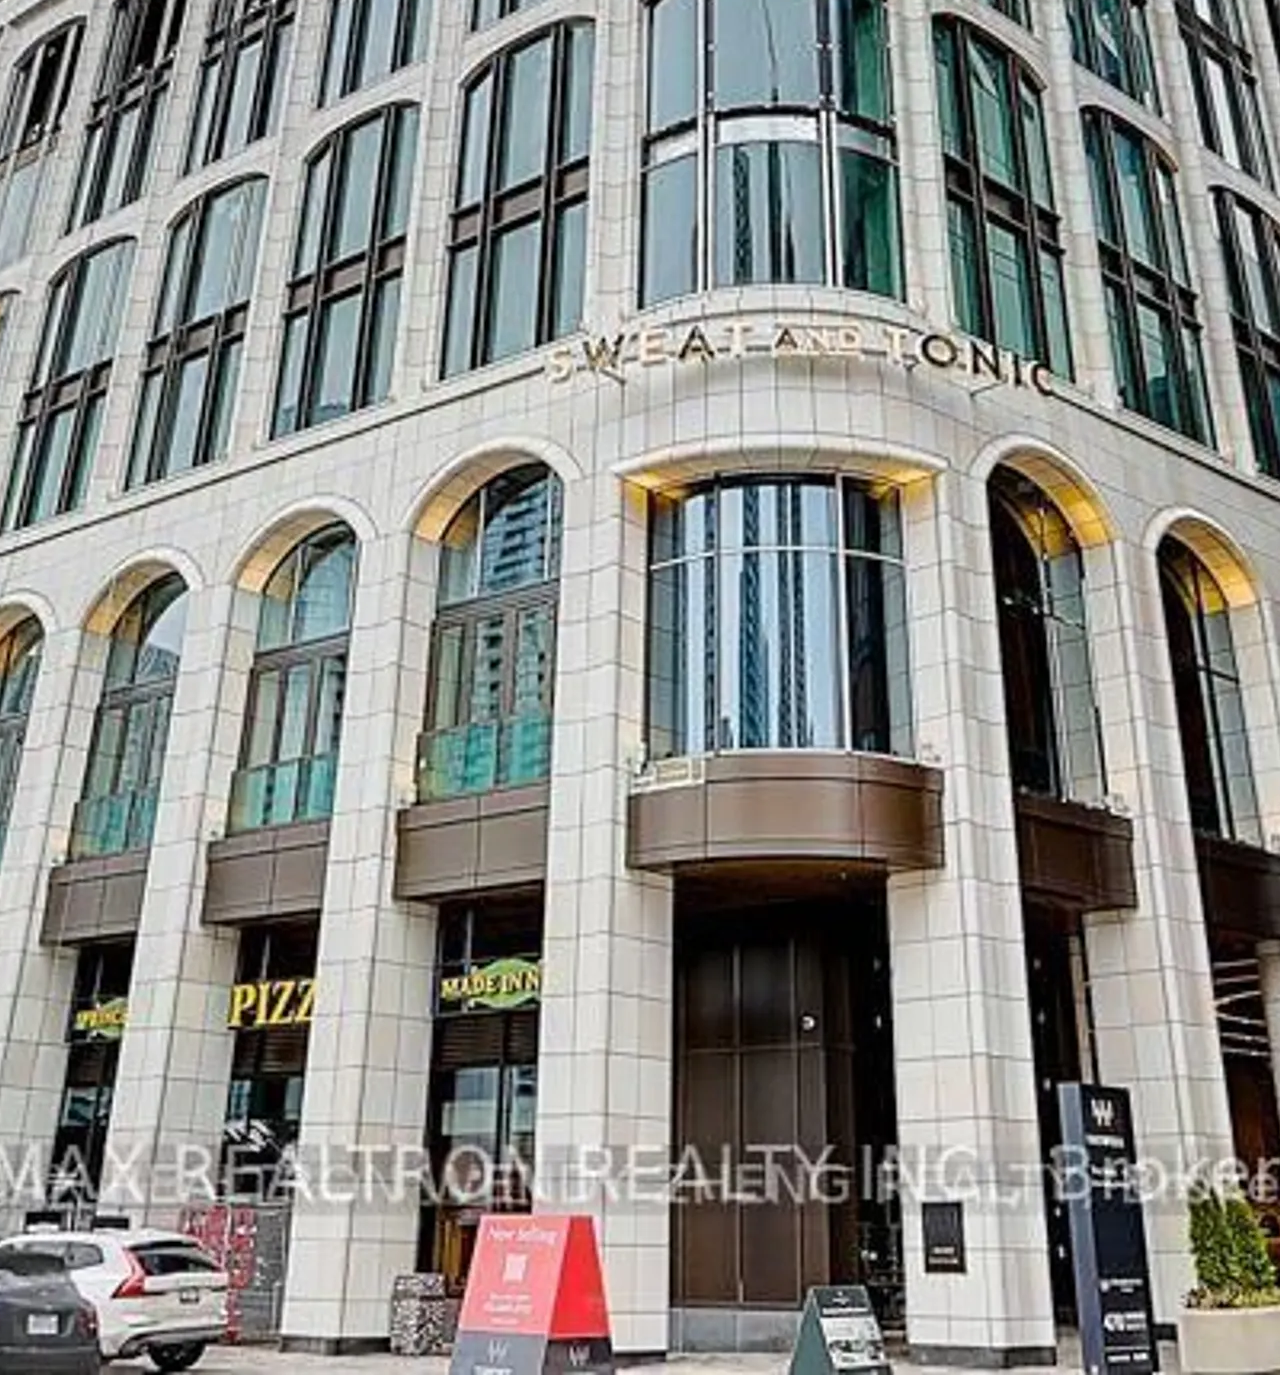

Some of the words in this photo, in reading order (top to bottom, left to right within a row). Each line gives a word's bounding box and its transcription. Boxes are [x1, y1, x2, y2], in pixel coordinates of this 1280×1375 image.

[547, 324, 755, 383] SWEAT
[774, 325, 861, 355] AND
[884, 328, 1054, 395] TONIC
[441, 971, 497, 998] MADE
